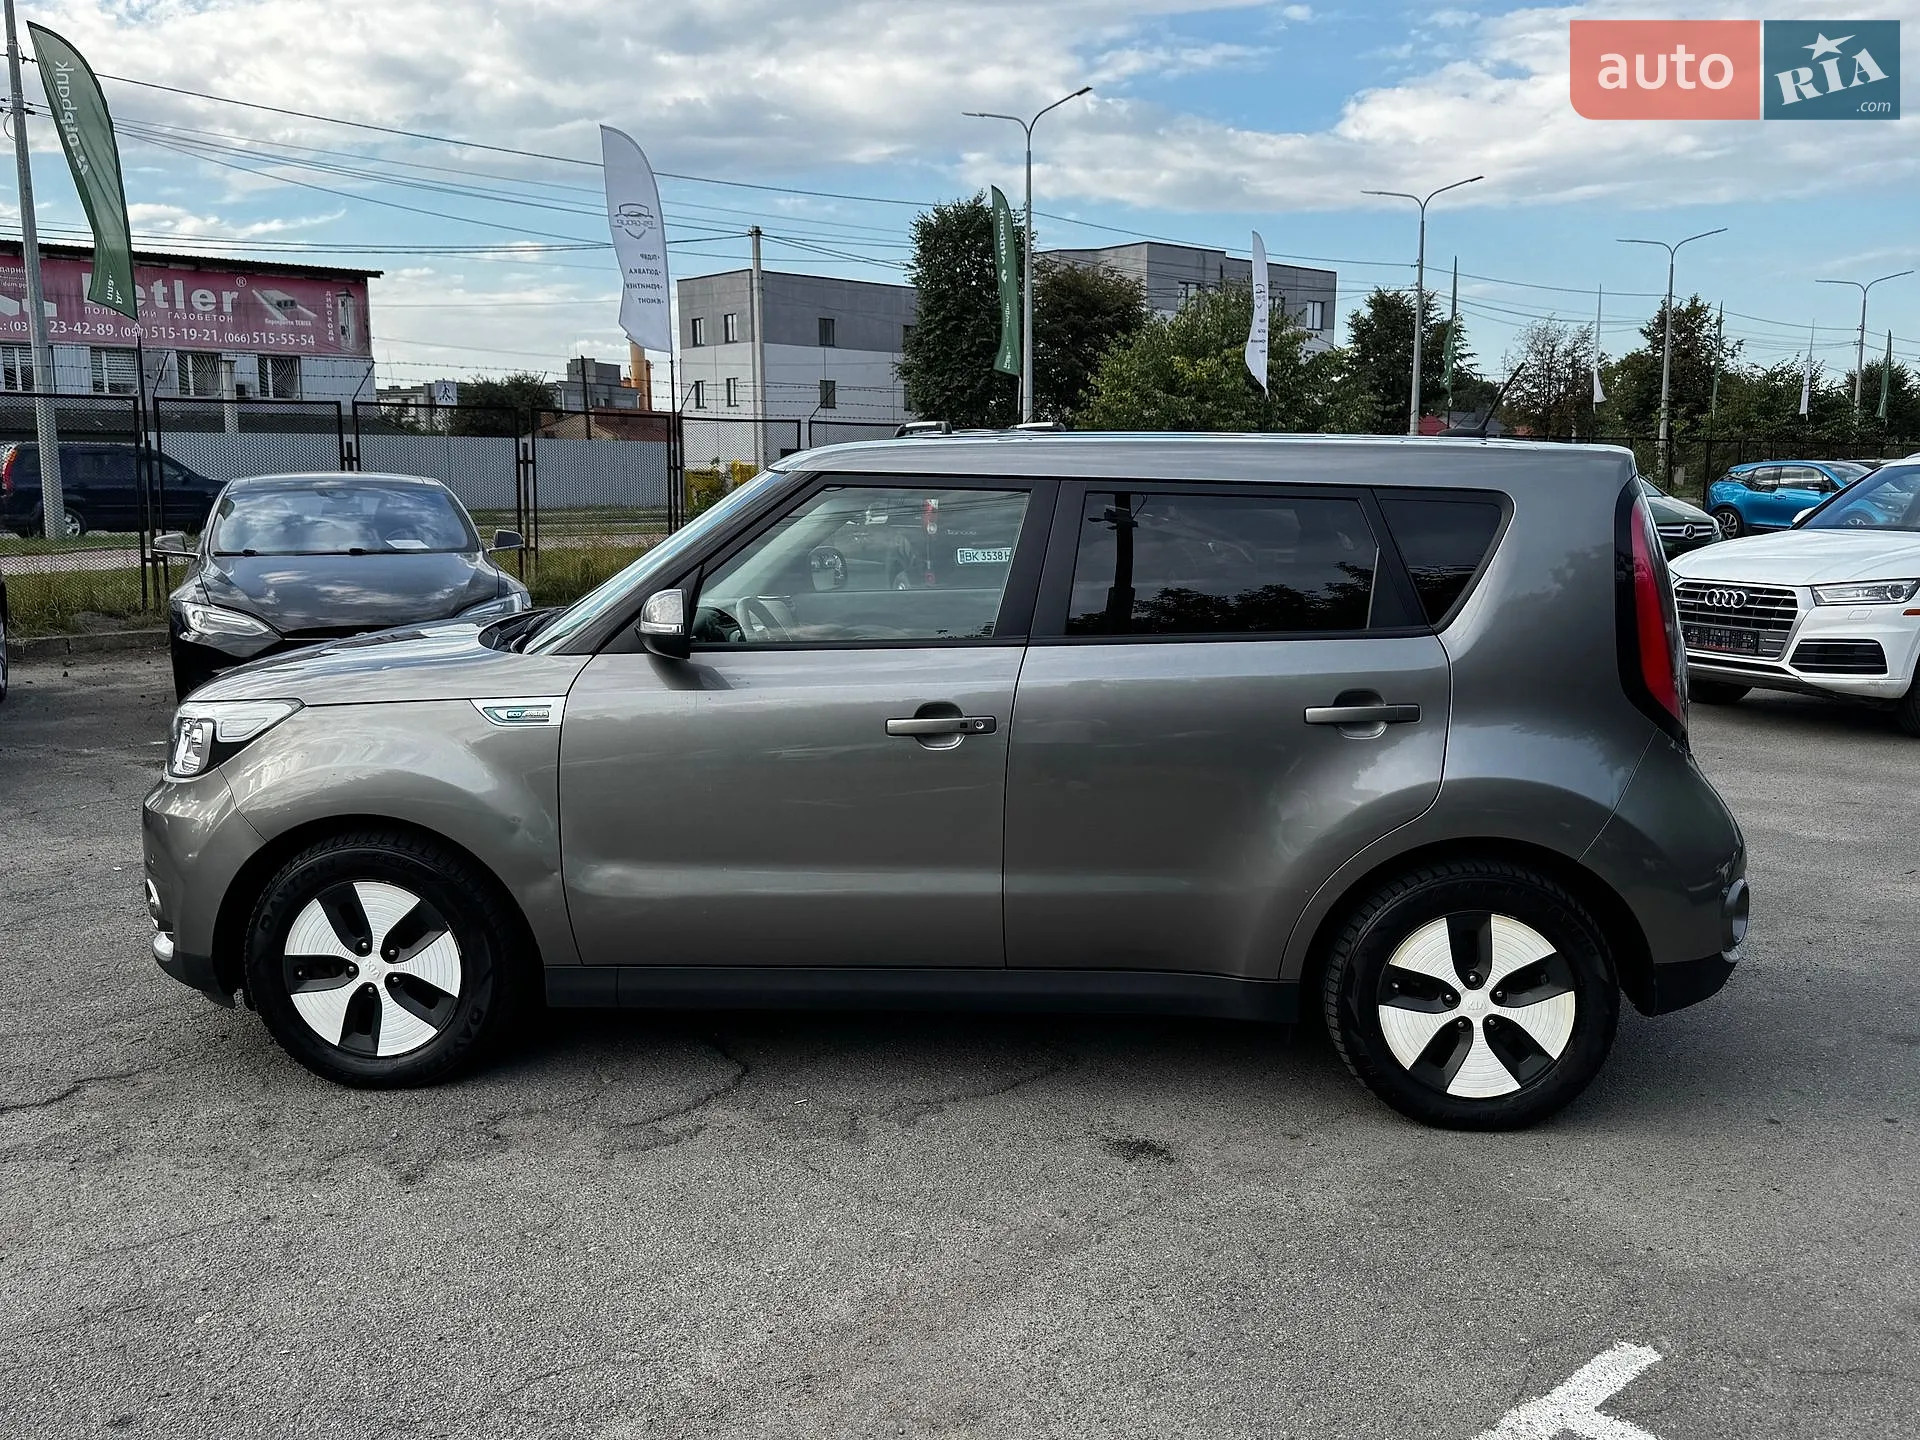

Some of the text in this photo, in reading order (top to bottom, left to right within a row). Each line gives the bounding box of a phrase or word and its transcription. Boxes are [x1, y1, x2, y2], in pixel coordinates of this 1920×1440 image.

[82, 273, 239, 313] tler
[168, 312, 233, 323] ГАЗОБЕТОН
[224, 332, 250, 344] (066)
[252, 332, 315, 345] 515-55-54
[965, 551, 979, 561] BK
[981, 551, 1003, 561] 3538
[1465, 1000, 1488, 1010] KIA
